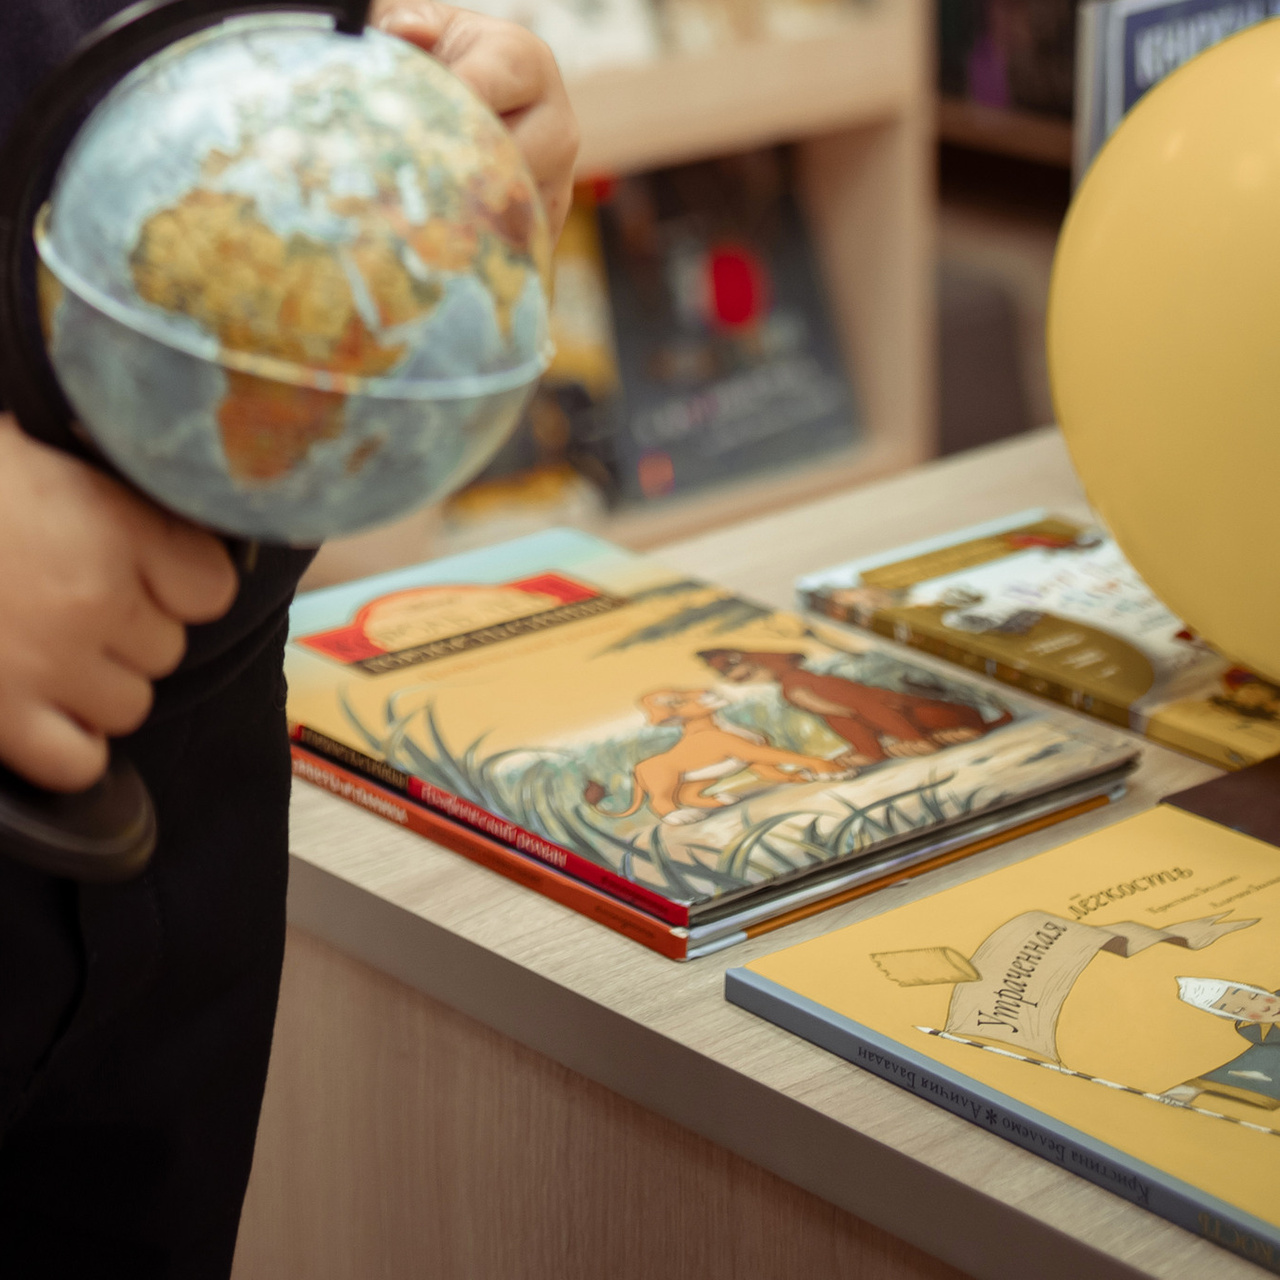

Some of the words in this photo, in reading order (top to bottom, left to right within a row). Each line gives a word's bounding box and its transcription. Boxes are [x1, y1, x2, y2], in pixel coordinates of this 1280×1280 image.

[977, 921, 1067, 1033] Утраченная
[857, 1045, 916, 1090] Баладан
[921, 1076, 982, 1119] Аличия
[1002, 1116, 1066, 1162] Беллемо
[1071, 1149, 1150, 1205] Кристина
